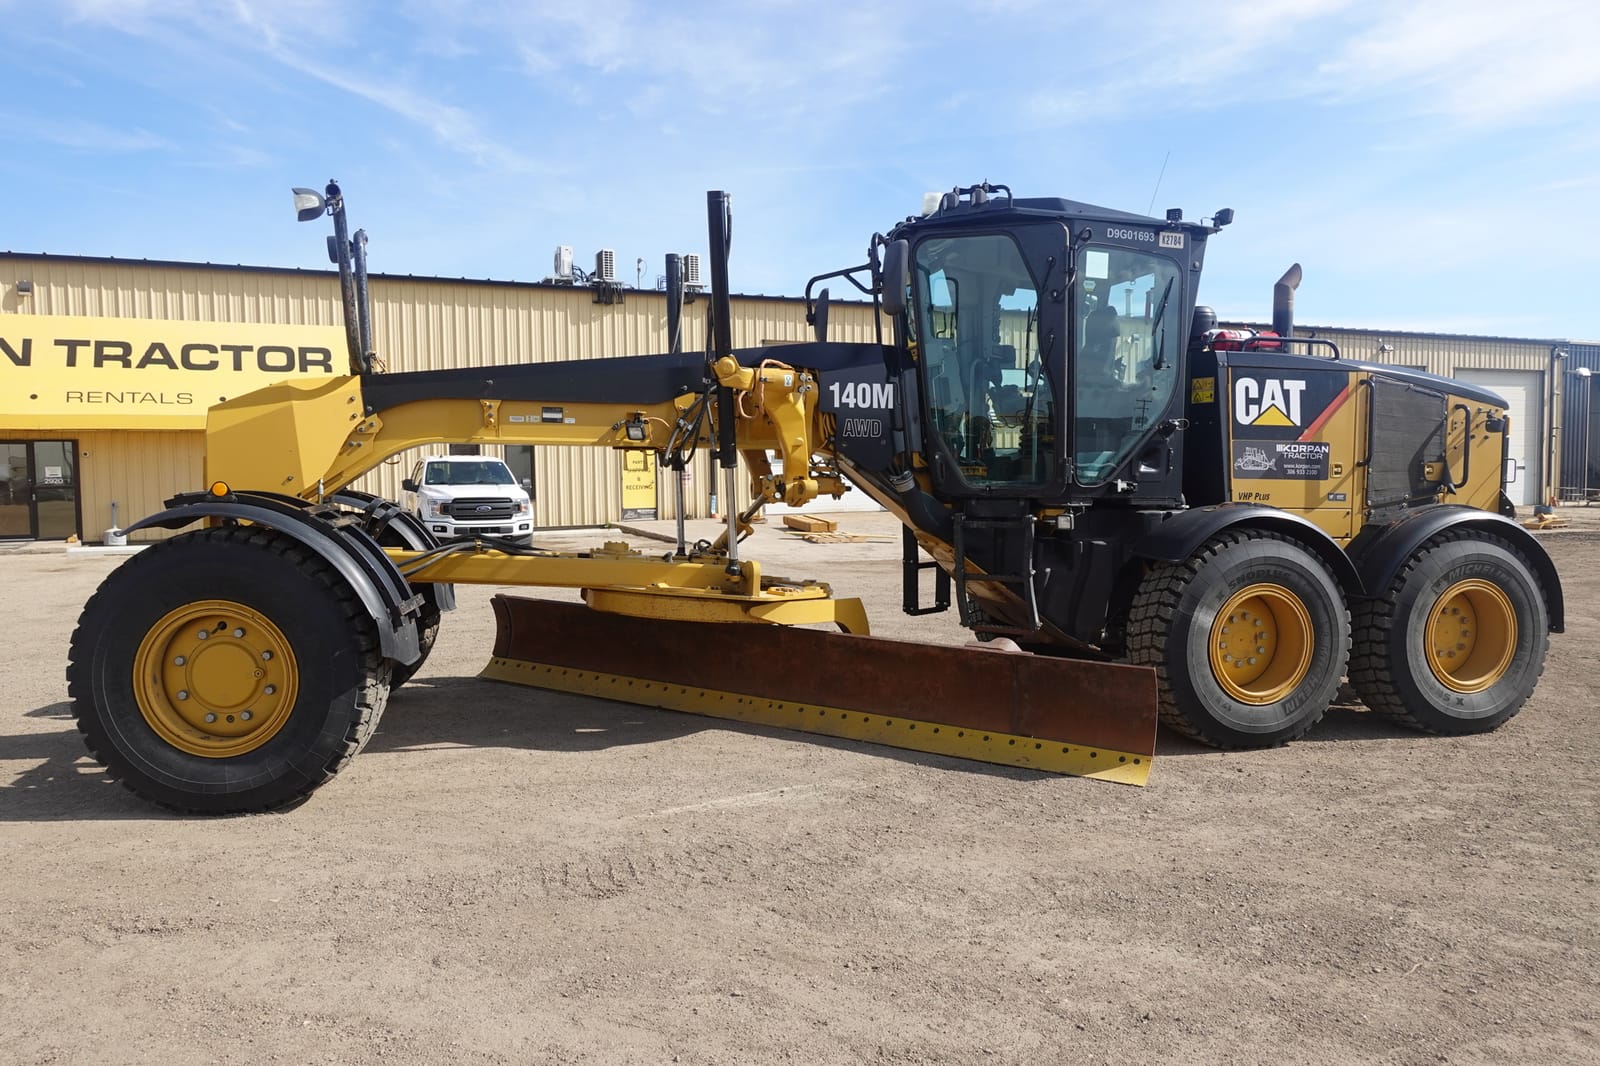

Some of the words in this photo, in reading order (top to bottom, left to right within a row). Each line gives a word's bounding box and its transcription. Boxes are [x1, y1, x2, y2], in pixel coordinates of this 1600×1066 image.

[1107, 228, 1155, 242] D9G01693
[1161, 233, 1182, 246] K2784
[54, 339, 333, 373] TRACTOR
[66, 391, 193, 404] RENTALS
[829, 382, 894, 409] 140M
[1235, 377, 1306, 427] CAT
[842, 418, 882, 438] AWD
[1279, 444, 1329, 453] KORPAN
[1282, 452, 1323, 460] TRACTOR
[1238, 492, 1253, 501] VHP
[1448, 563, 1510, 581] MICHELIN
